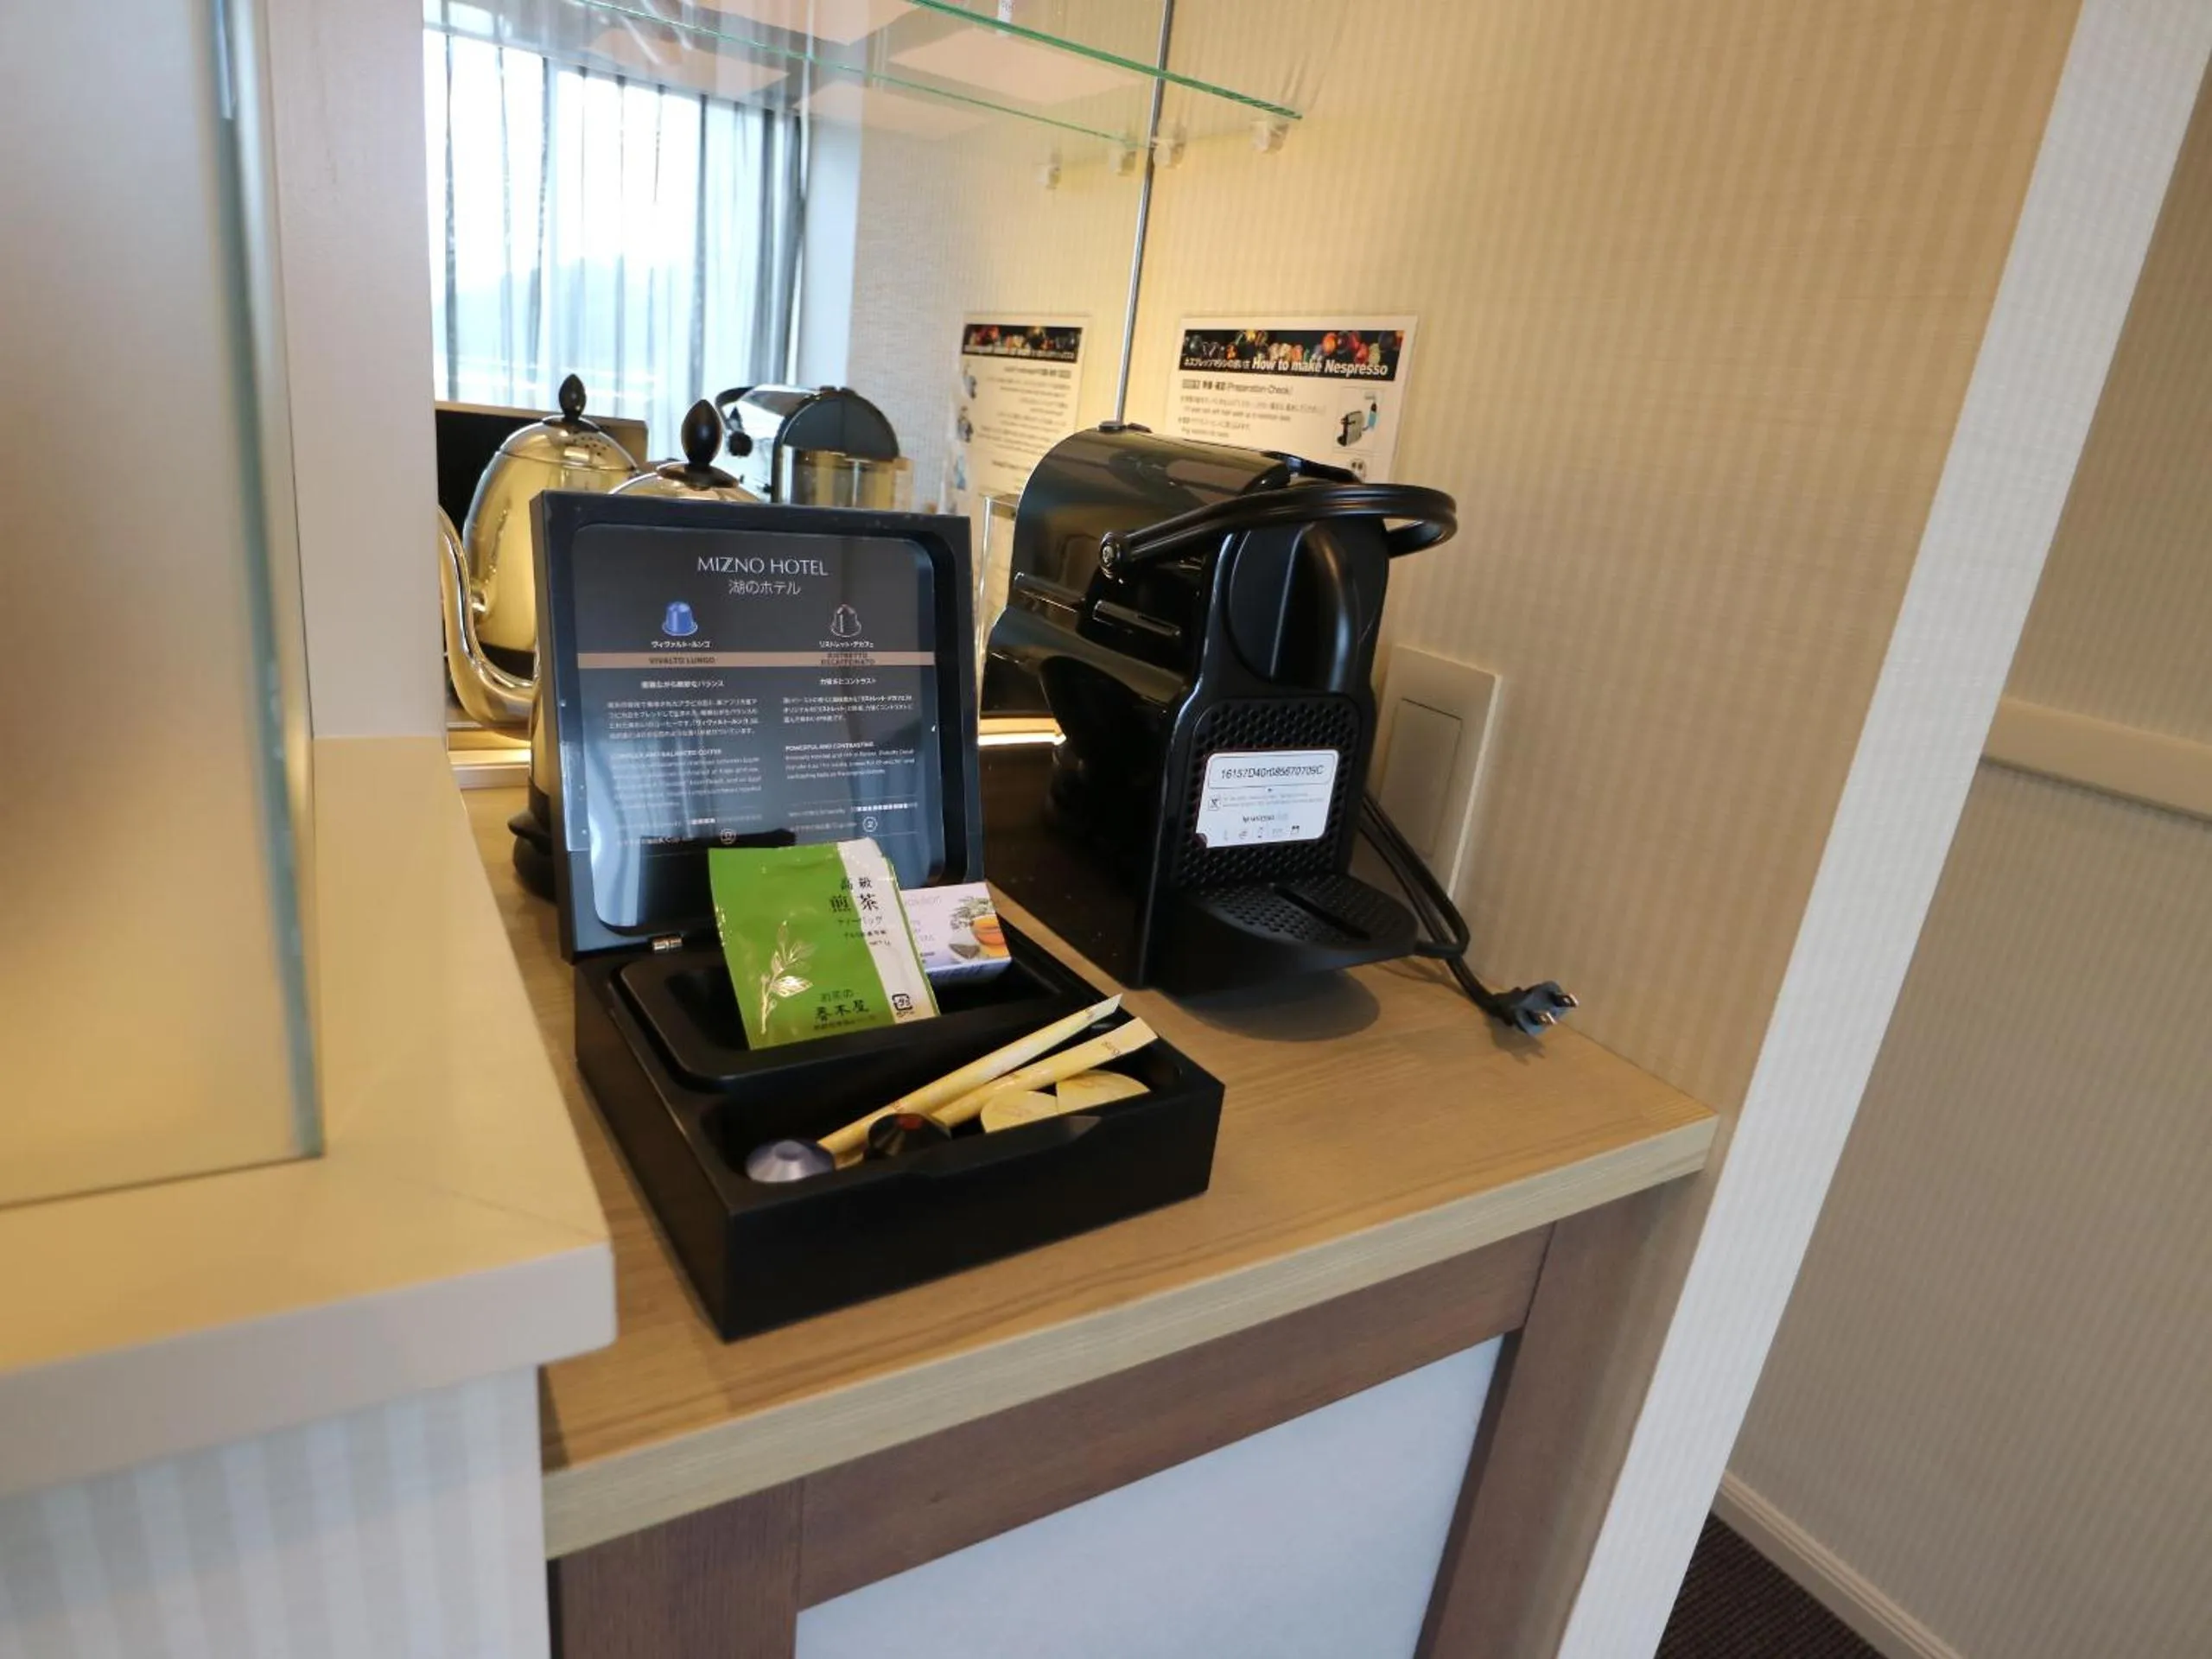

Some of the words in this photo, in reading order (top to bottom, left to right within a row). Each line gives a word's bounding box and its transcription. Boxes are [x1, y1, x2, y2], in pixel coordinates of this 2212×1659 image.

[1252, 358, 1276, 371] How
[1278, 360, 1290, 372] to
[1291, 359, 1322, 372] make
[1324, 360, 1389, 377] Nespresso
[696, 556, 765, 574] MIZNO
[770, 558, 830, 576] HOTEL
[728, 580, 802, 595] 湖のホテル
[649, 657, 686, 665] VIVALTO
[830, 893, 880, 912] 煎茶
